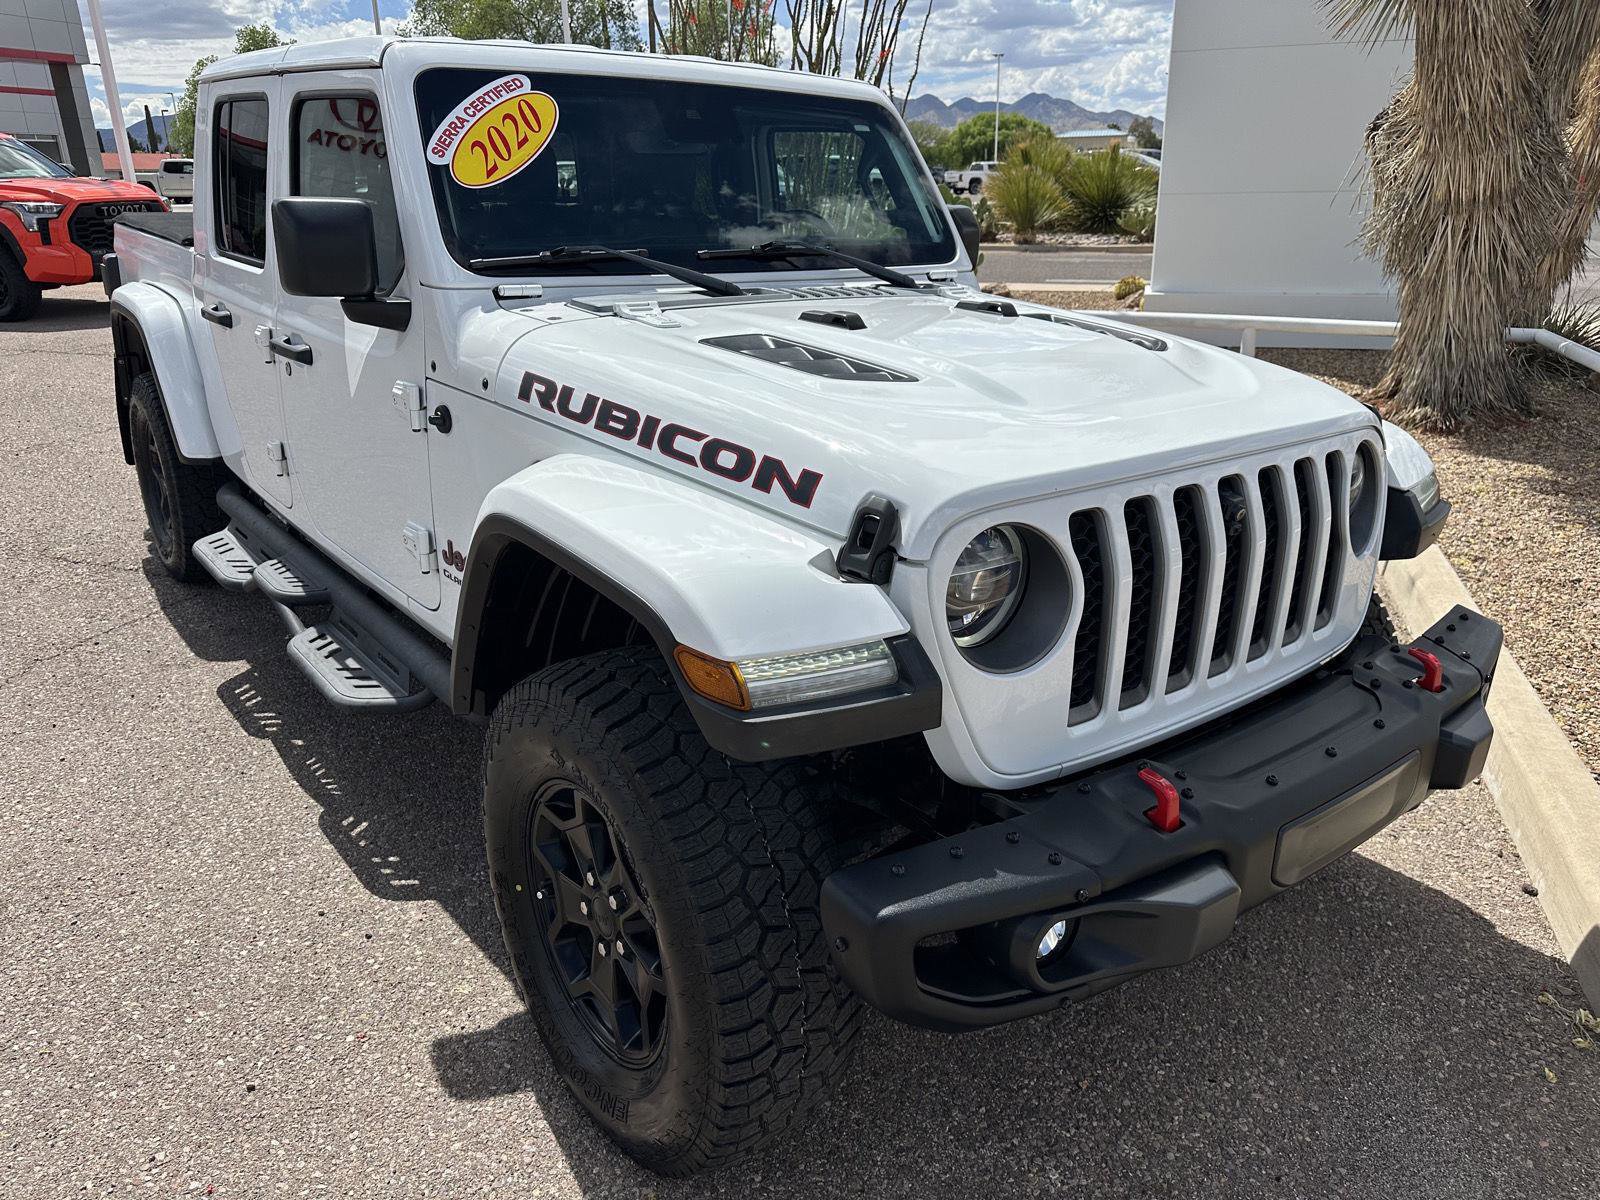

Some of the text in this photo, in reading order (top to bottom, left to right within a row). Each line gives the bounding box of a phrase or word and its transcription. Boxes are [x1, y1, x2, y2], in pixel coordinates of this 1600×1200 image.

[431, 77, 525, 158] SIERRA CERTIFIED
[470, 98, 542, 179] 2020
[101, 203, 148, 216] TOYOTA
[517, 370, 824, 509] RUBICON
[442, 539, 467, 572] Je
